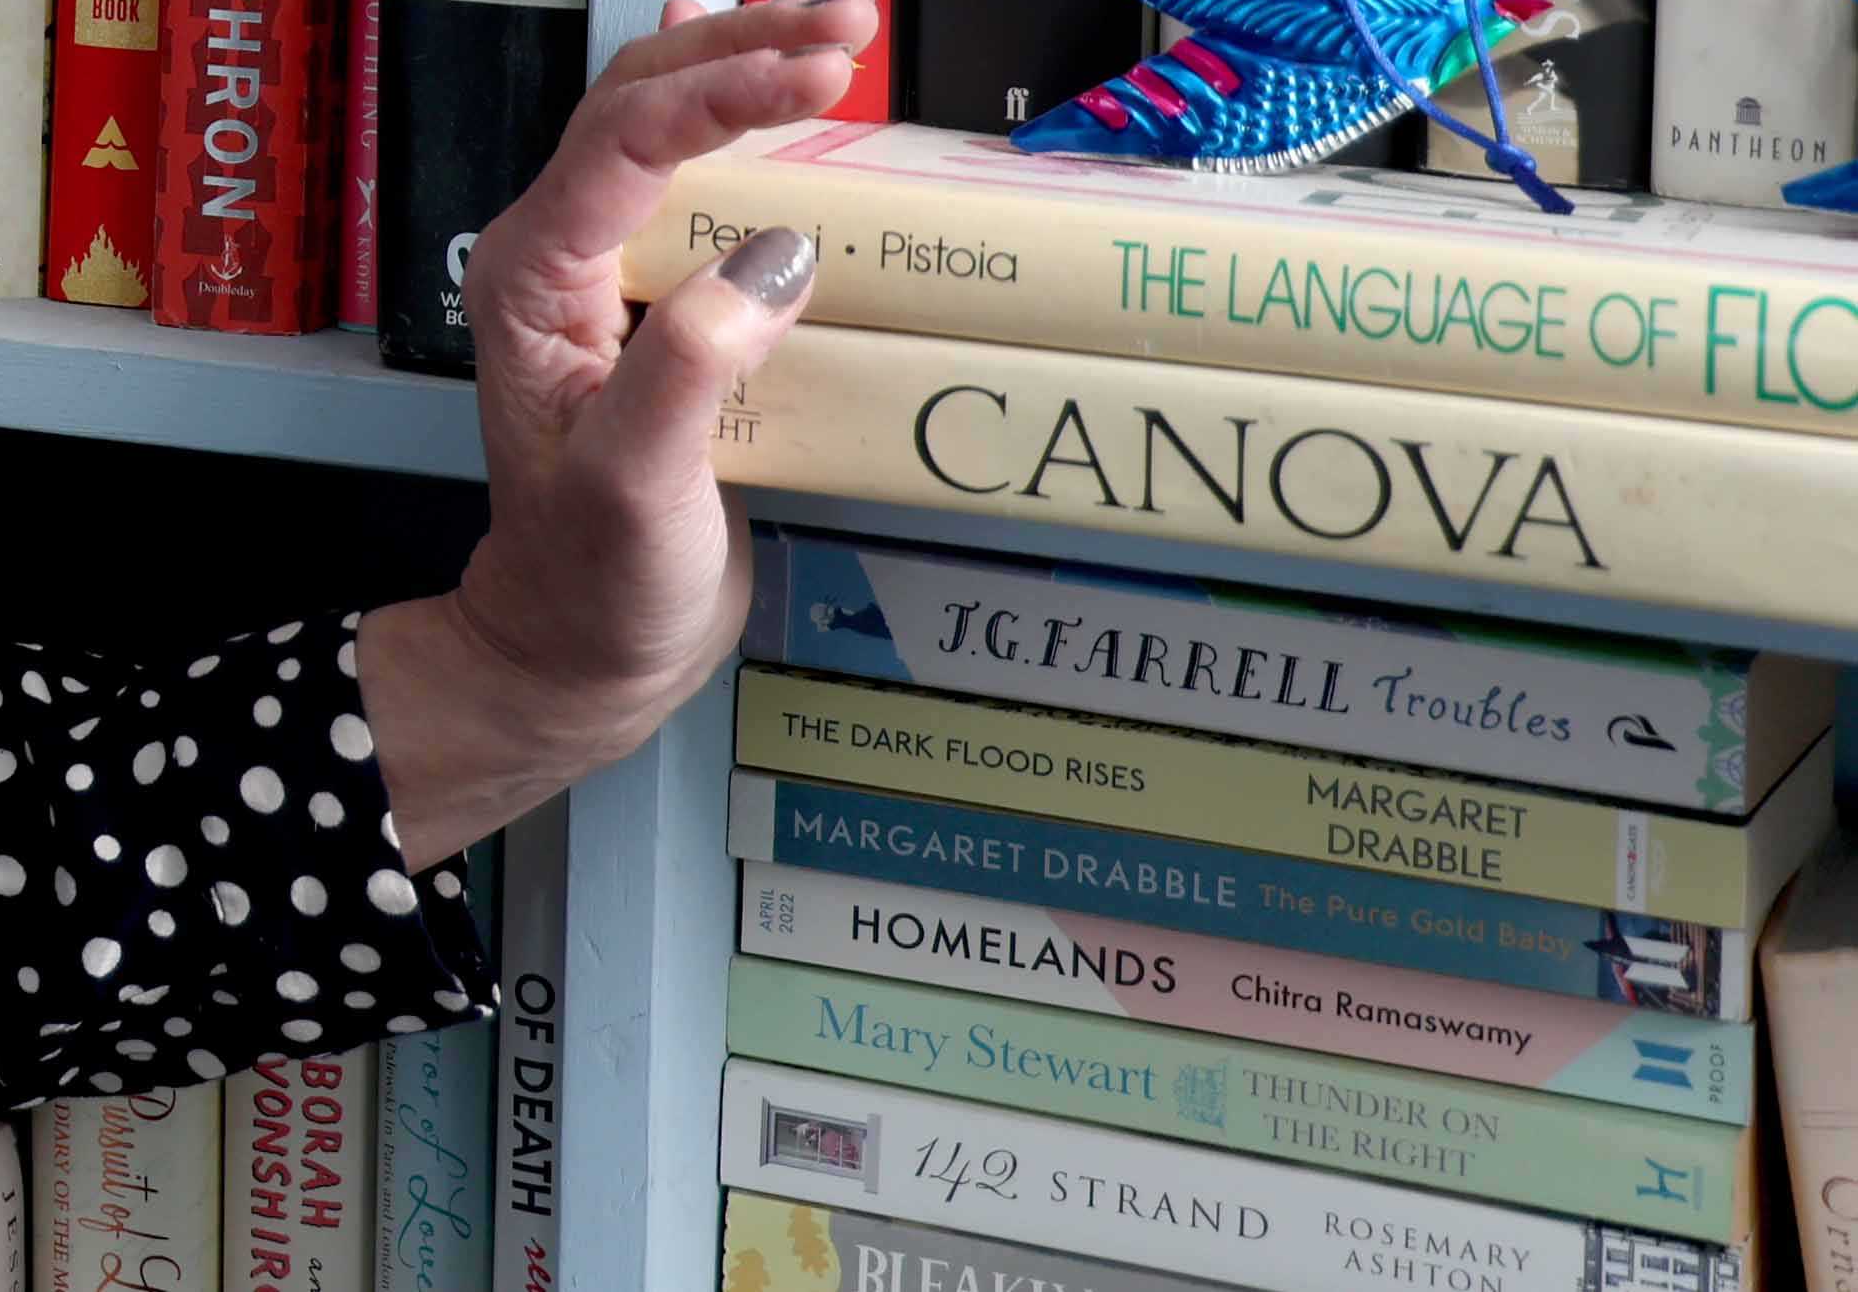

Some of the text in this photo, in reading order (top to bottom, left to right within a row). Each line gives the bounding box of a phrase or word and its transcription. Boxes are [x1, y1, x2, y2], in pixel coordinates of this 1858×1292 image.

[1671, 127, 1827, 165] PANTHEON
[880, 229, 1678, 372] Pistoia THE LANGUAGE OF
[914, 383, 1610, 573] CANOVA
[814, 994, 1158, 1102] Mary Stewart
[852, 905, 1533, 1056] HOMELANDS Chitra Ramaswamy
